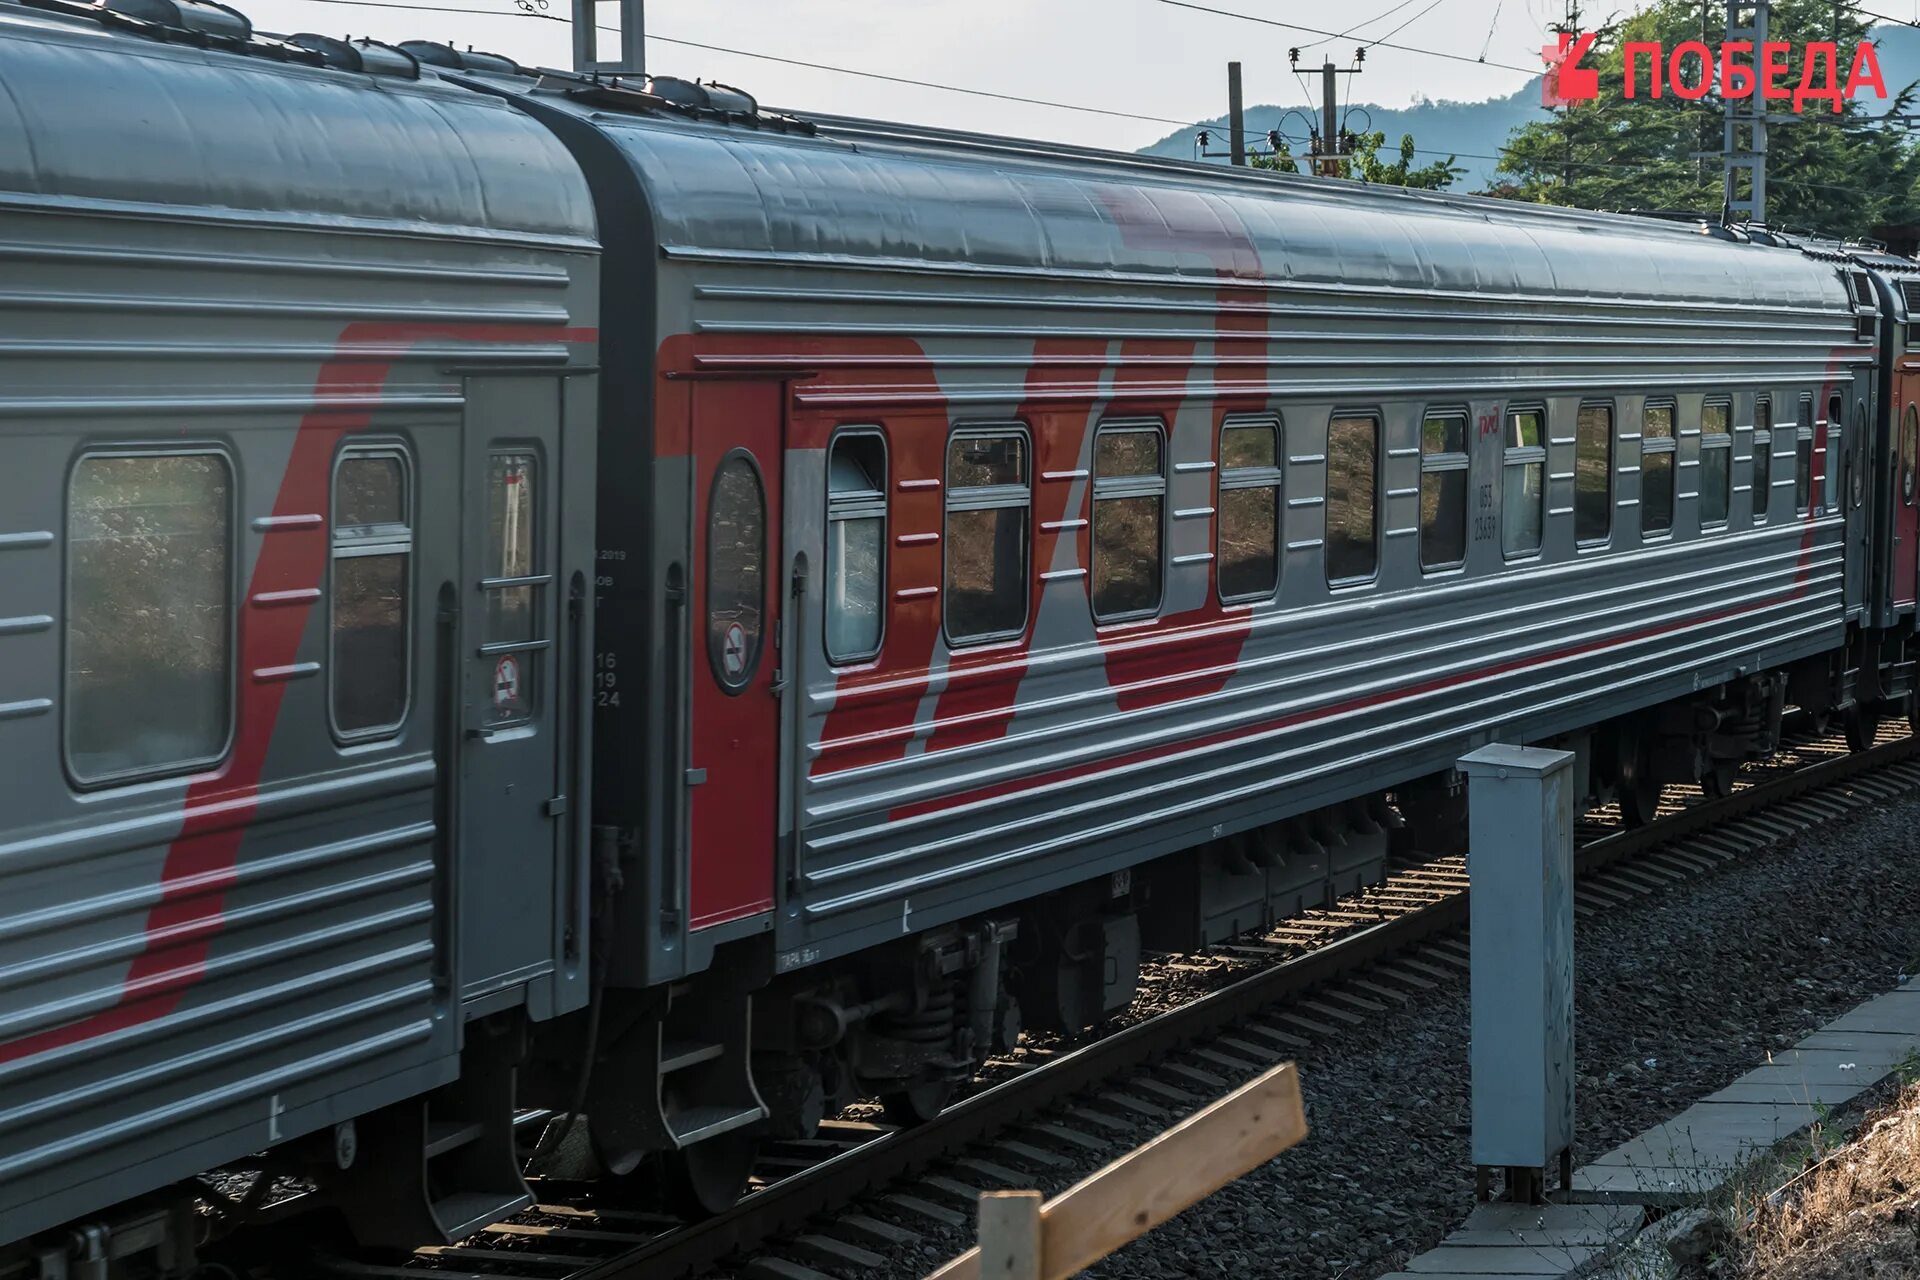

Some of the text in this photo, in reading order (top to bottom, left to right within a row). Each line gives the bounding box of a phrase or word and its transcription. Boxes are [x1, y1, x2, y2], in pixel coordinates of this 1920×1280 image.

[1480, 484, 1492, 508] 053
[596, 653, 616, 668] 16
[596, 672, 616, 688] 19
